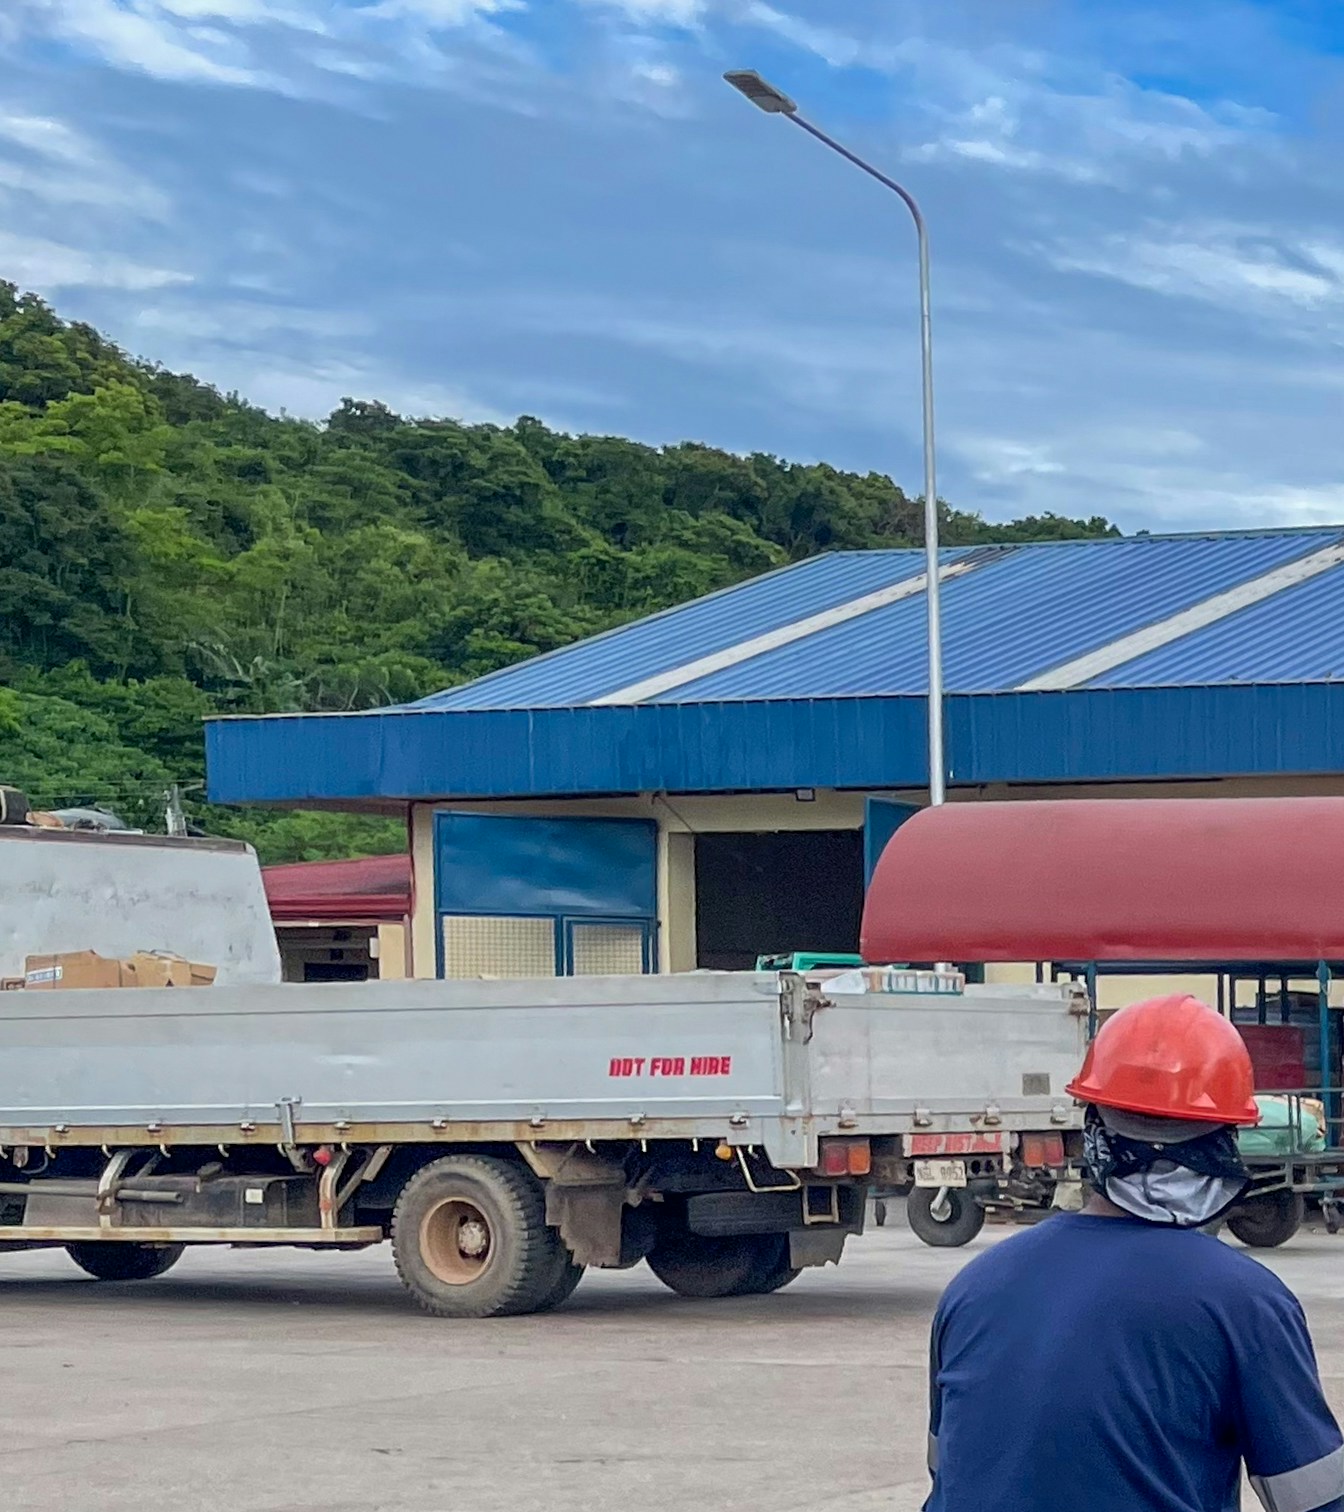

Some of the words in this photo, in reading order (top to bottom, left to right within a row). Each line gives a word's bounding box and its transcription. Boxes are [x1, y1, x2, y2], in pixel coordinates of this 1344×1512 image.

[608, 1057, 646, 1077] NOT
[649, 1056, 685, 1077] FOR
[690, 1055, 731, 1076] HIRE
